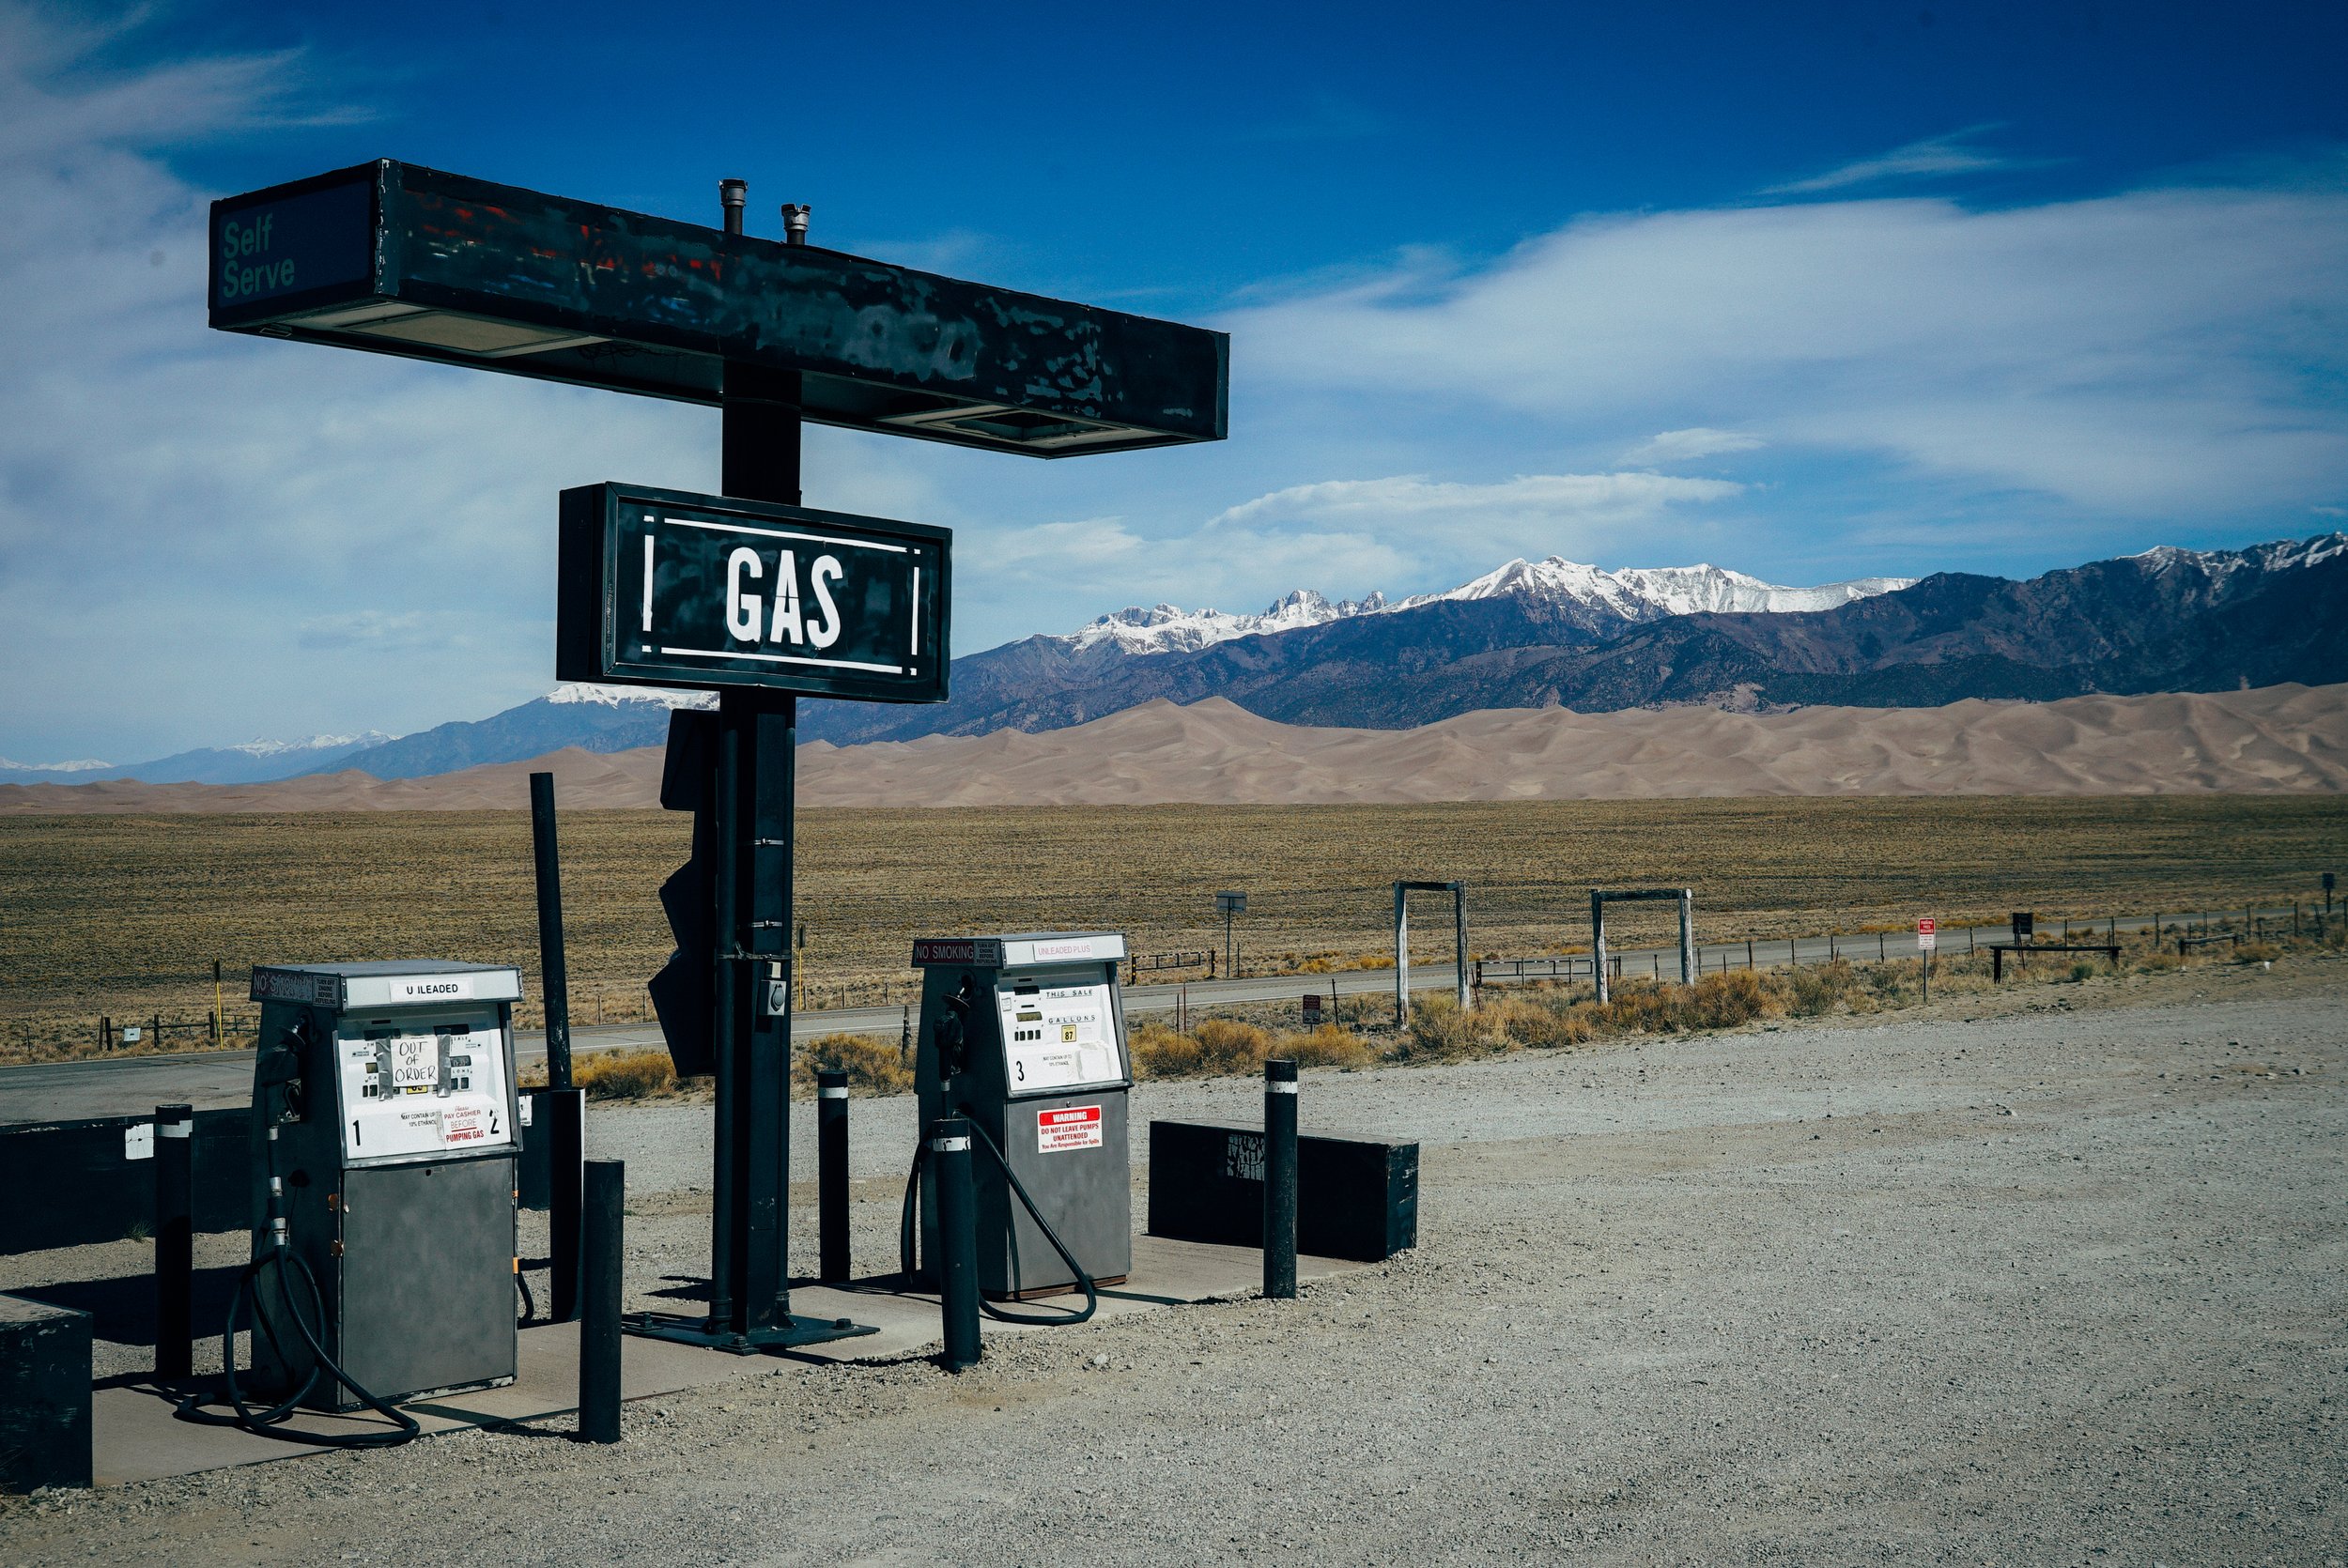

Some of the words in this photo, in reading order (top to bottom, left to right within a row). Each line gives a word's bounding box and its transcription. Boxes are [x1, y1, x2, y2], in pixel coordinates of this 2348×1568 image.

[224, 213, 273, 259] Self
[224, 257, 295, 298] Serve
[725, 546, 843, 649] GAS
[916, 945, 929, 959] NO
[933, 945, 973, 959] SMOKING
[1038, 946, 1073, 955] UNLEADED
[1074, 945, 1090, 953] PLUS
[254, 974, 267, 992] NO
[1048, 1015, 1096, 1023] GALLONS
[1064, 1031, 1074, 1040] 87
[399, 1041, 428, 1056] OUT
[395, 1066, 437, 1082] ORDER
[1016, 1060, 1025, 1081] 3
[456, 1109, 481, 1118] CASHIER
[1053, 1112, 1088, 1123] WARNING
[451, 1118, 476, 1129] BEFORE
[489, 1109, 500, 1134] 2
[352, 1119, 361, 1145] 1
[446, 1132, 471, 1143] PUMPING
[472, 1130, 484, 1139] GAS
[1053, 1132, 1088, 1142] UNATTENDED
